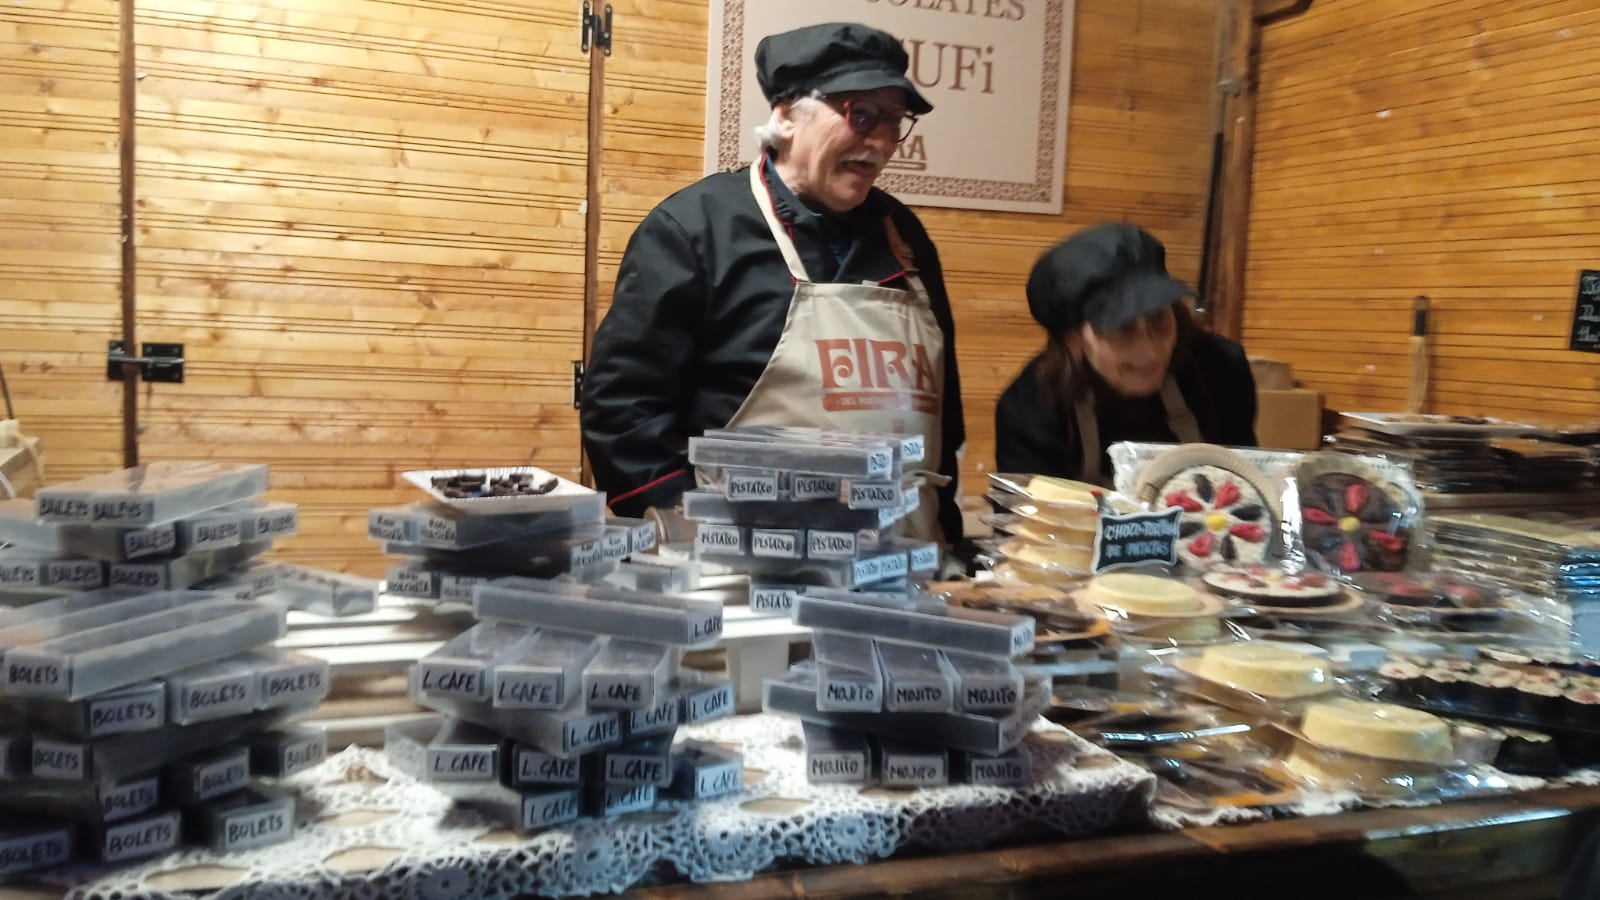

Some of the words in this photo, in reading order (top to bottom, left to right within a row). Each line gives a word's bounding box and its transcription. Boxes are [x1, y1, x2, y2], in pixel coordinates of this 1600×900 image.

[814, 338, 937, 393] FIRA
[39, 499, 89, 517] BAILEYS
[94, 502, 143, 519] BAILEYS
[197, 522, 239, 544] BAILEYS
[9, 664, 59, 685] BOLETS
[269, 671, 321, 695] BOLETS
[190, 684, 246, 708] BOLETS
[897, 688, 943, 704] MOJITO
[967, 686, 1017, 704] MOJITO
[91, 703, 156, 725] BOLETS
[34, 749, 79, 770] BOLETS
[286, 746, 323, 769] BOLETS
[812, 756, 859, 776] MOJITO
[202, 766, 246, 790] BOLETS
[890, 765, 938, 780] MOJITO
[975, 760, 1023, 780] MOJITO
[103, 789, 150, 813] BOLETS
[109, 822, 171, 852] BOLETS
[228, 813, 284, 843] BOLETS
